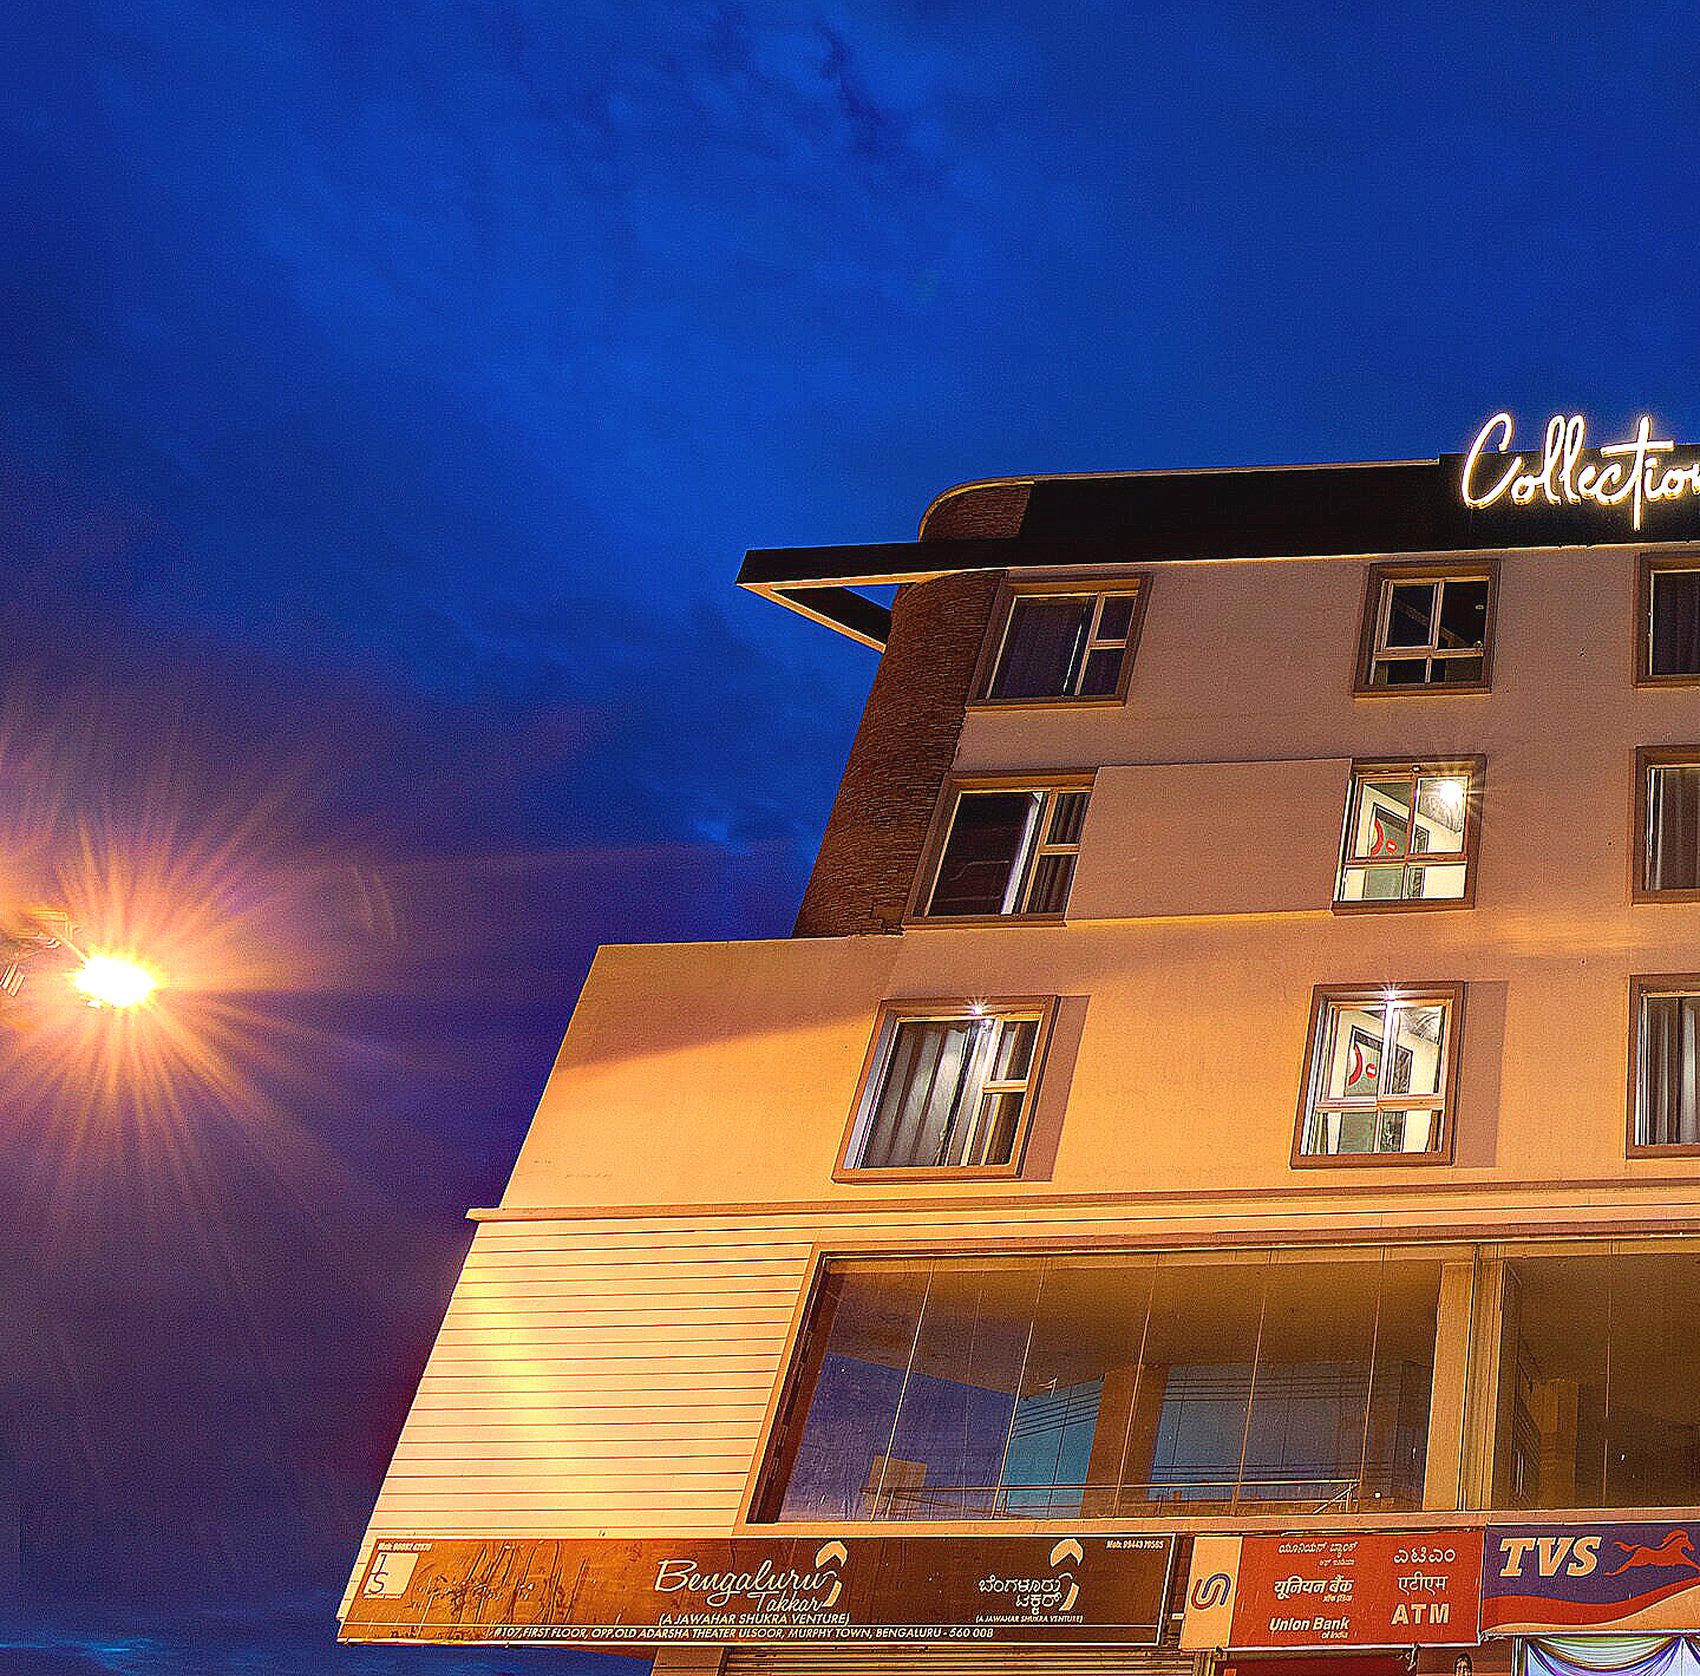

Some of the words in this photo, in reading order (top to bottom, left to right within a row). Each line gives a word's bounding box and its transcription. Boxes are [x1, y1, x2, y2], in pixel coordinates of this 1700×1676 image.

[1499, 1536, 1602, 1577] TVS
[655, 1559, 829, 1607] Bengaluru
[978, 1574, 1061, 1592] ಬೆಂಗಳೂರು
[1274, 1575, 1328, 1600] यूनियन
[1329, 1574, 1354, 1593] बैंक
[1397, 1571, 1449, 1596] एटीएम
[747, 1590, 824, 1613] Takkar
[674, 1613, 735, 1625] JAWAHAR
[738, 1613, 788, 1625] SHUKRA
[791, 1612, 850, 1626] VENTURE)
[1269, 1617, 1310, 1631] Union
[1312, 1616, 1350, 1631] Bank
[1391, 1603, 1450, 1625] ATM
[551, 1627, 589, 1639] FLOOR,
[638, 1628, 690, 1639] ADARSHA
[691, 1628, 736, 1639] THEATER
[788, 1628, 832, 1638] MURPHY
[834, 1628, 873, 1639] TOWN,
[875, 1628, 942, 1638] BENGALURU
[949, 1628, 970, 1638] 560
